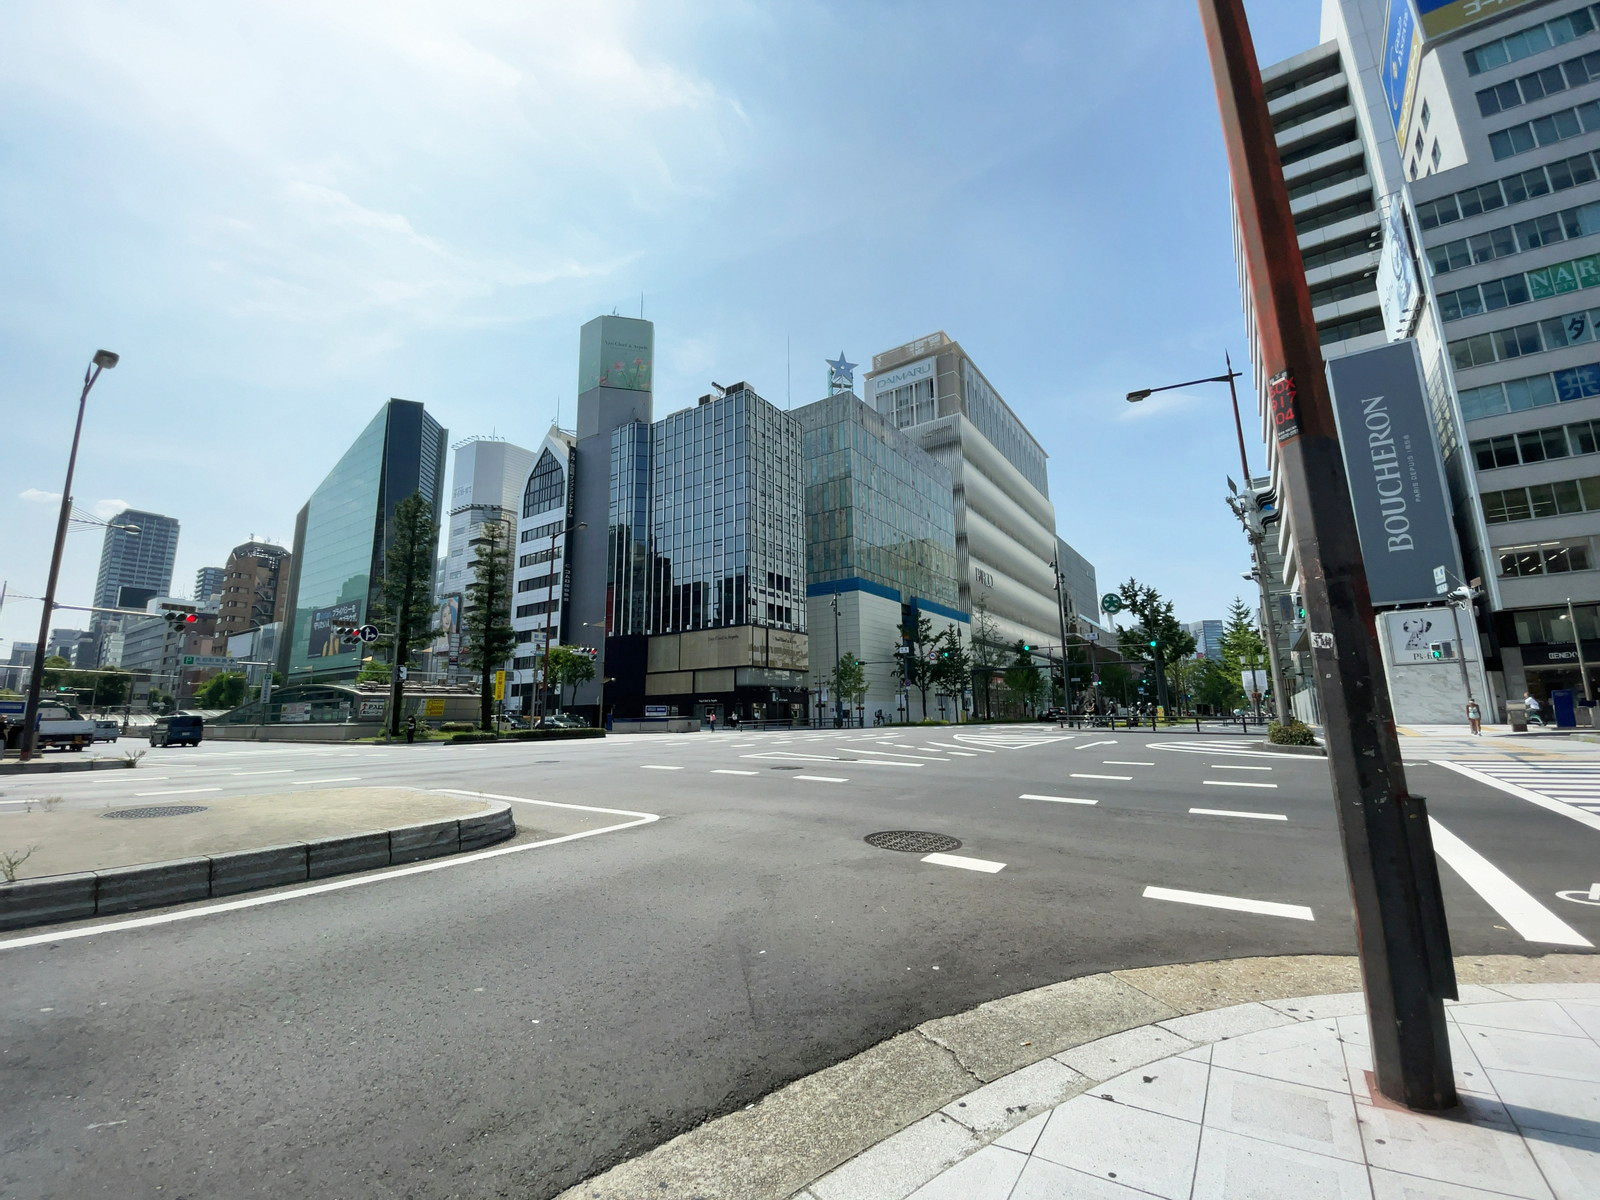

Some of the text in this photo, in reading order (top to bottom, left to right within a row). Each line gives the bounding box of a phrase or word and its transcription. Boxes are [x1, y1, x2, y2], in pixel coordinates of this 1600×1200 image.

[877, 363, 931, 389] DAIMARU
[1361, 395, 1414, 553] BOUCHERON
[1408, 454, 1417, 481] DEPUIS
[1411, 482, 1421, 503] PARIS
